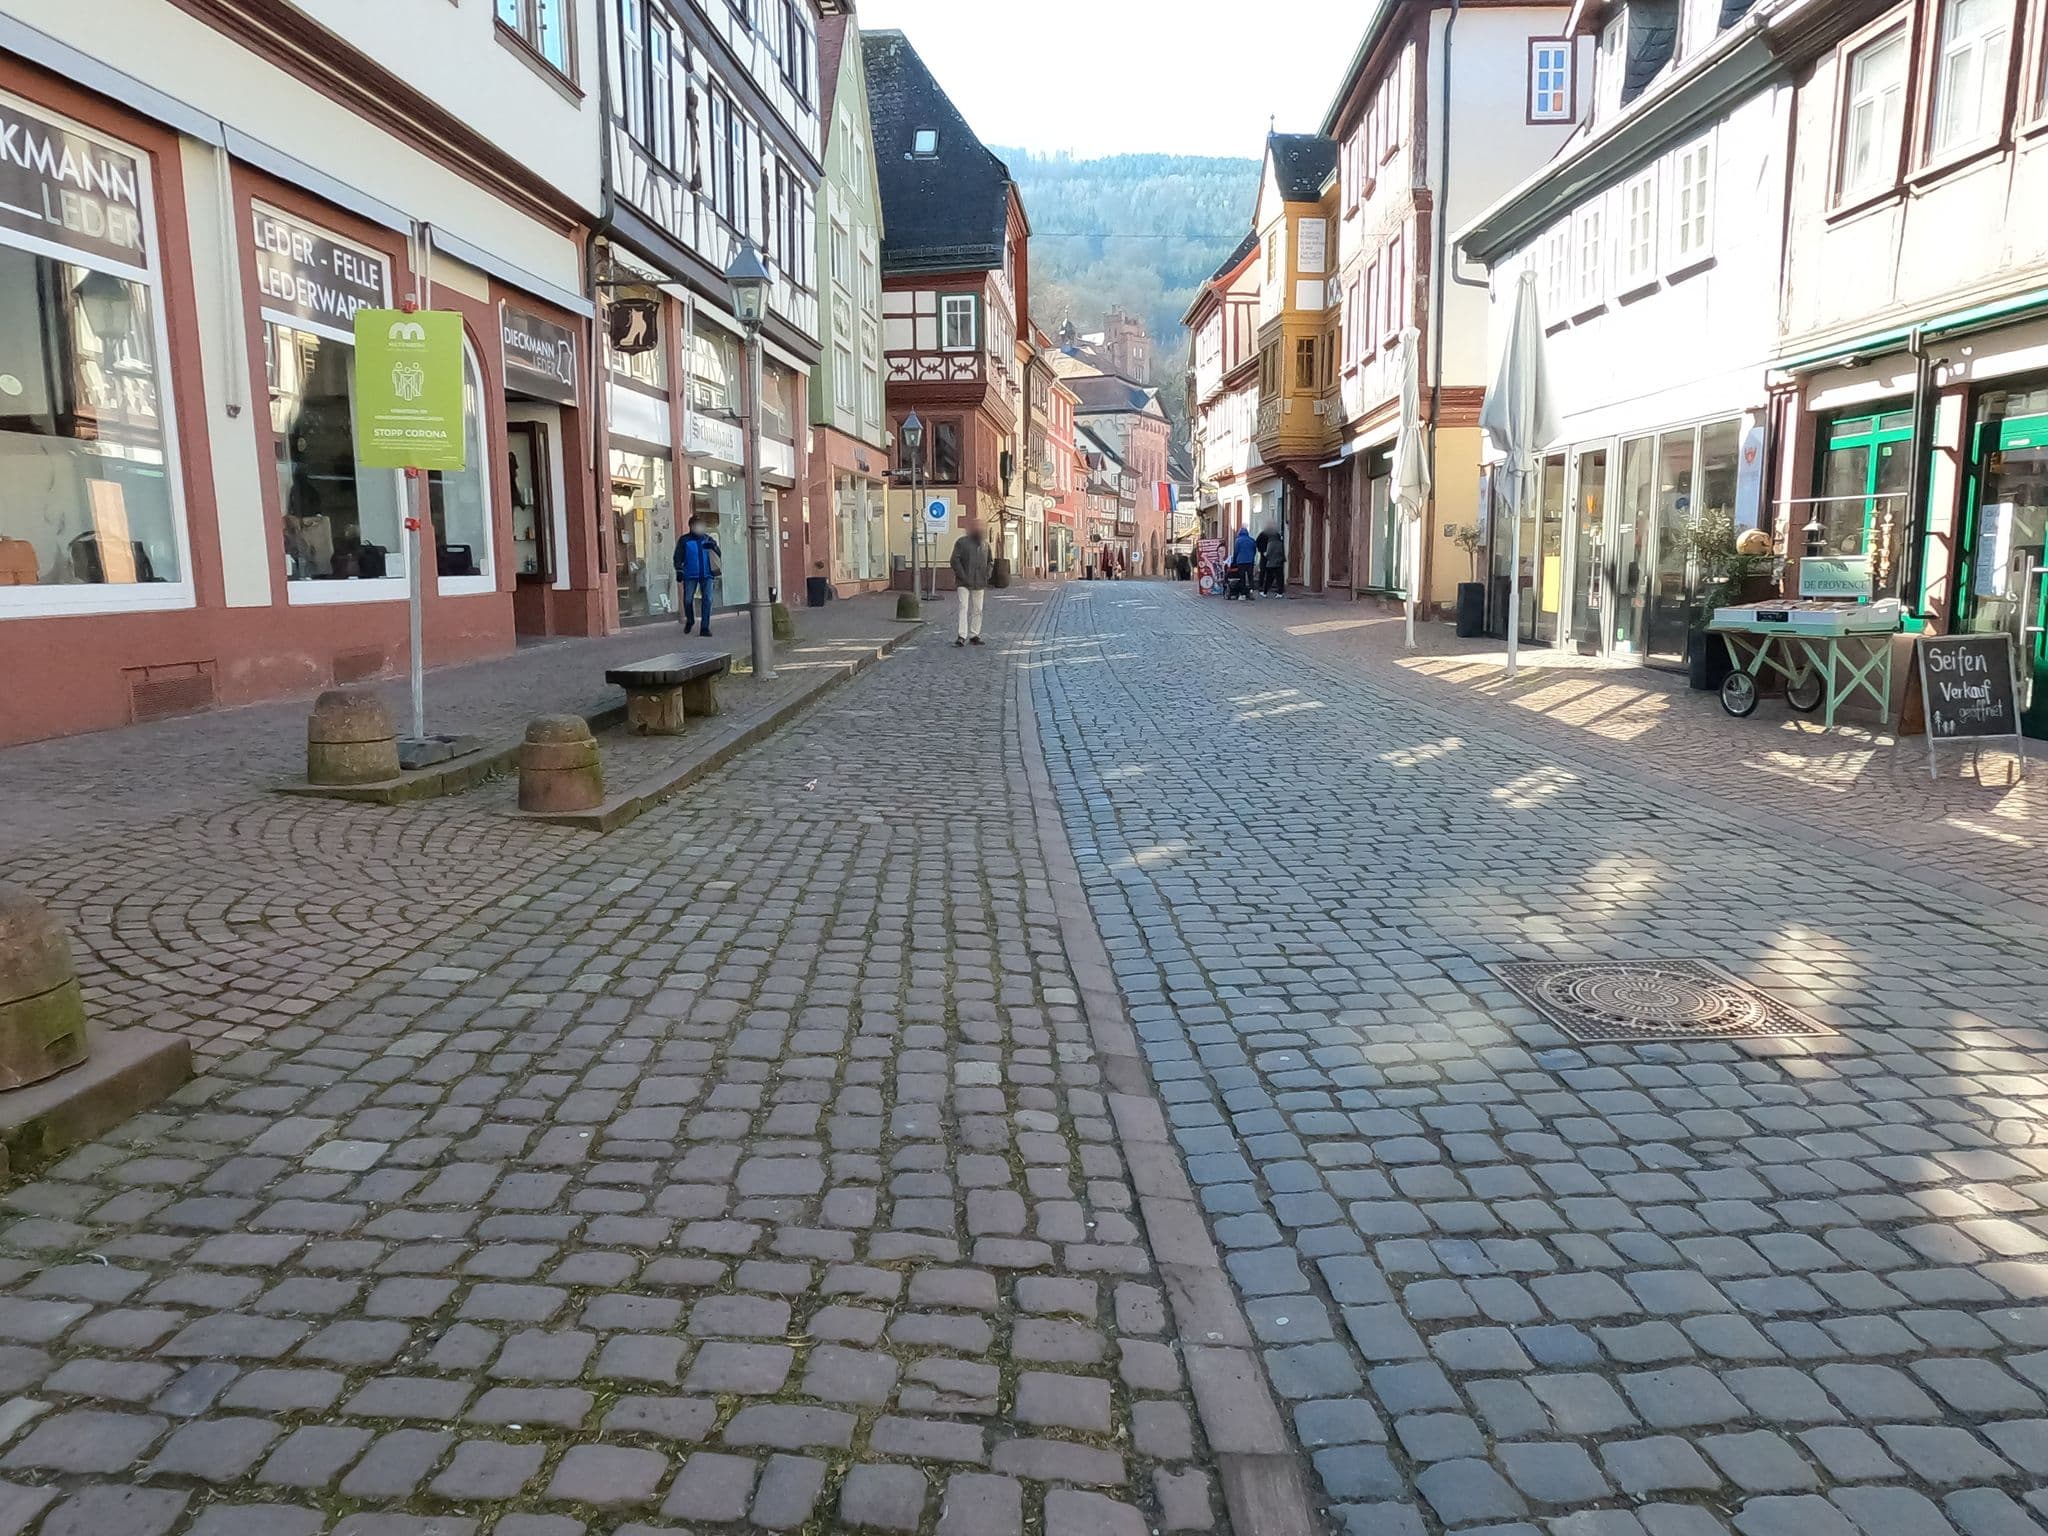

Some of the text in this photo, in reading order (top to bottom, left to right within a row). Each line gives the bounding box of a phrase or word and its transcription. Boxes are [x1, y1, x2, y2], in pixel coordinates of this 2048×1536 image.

[41, 182, 145, 253] LEDER
[253, 216, 316, 267] LEDER
[333, 248, 380, 291] FELLE
[503, 326, 555, 359] DIECKMANN
[373, 428, 447, 438] STOPP CORONA
[1804, 580, 1816, 590] DE
[1929, 646, 1988, 677] Seifen
[1939, 679, 1992, 705] Verkauf
